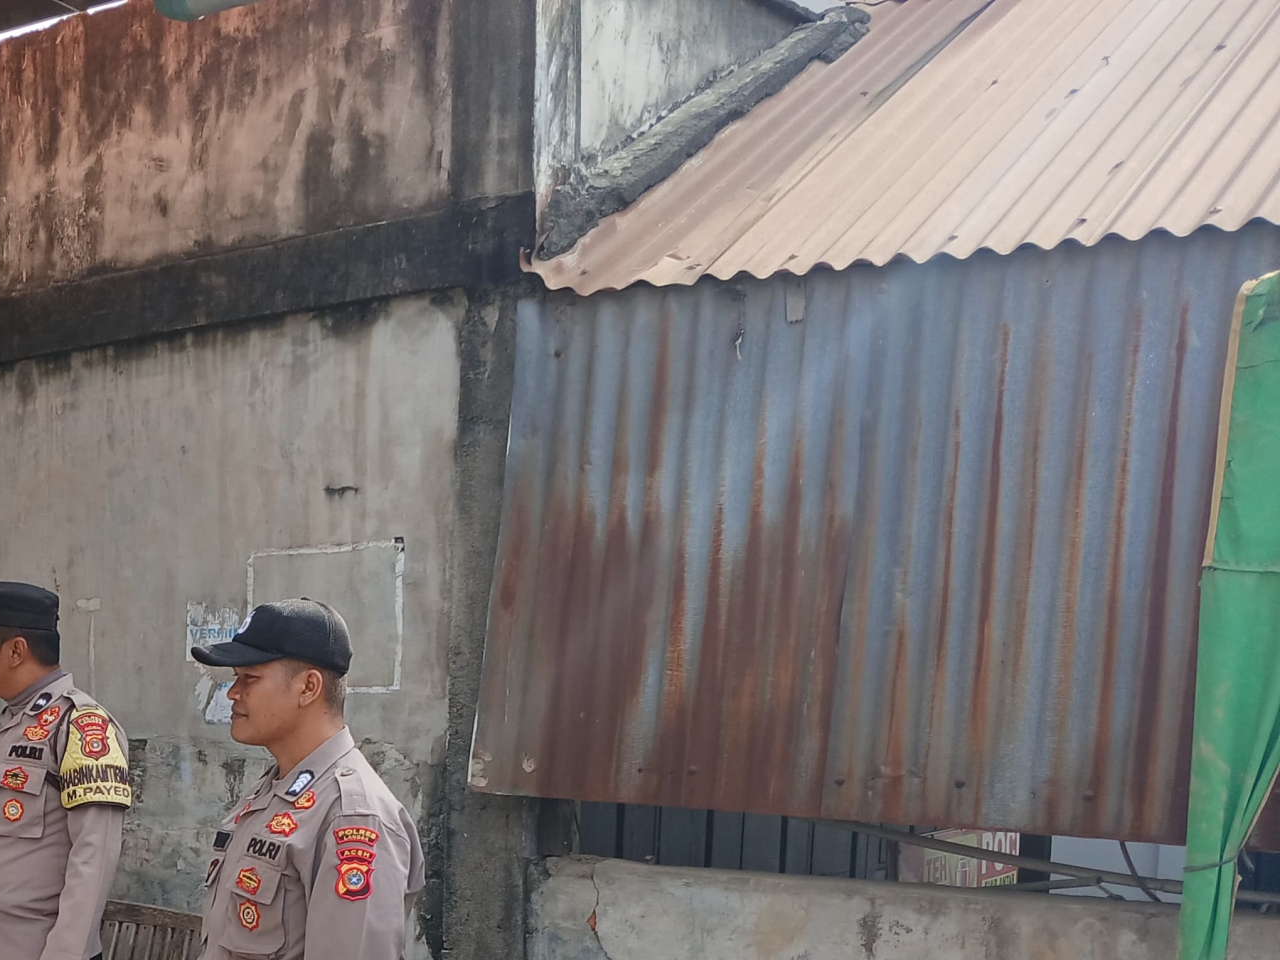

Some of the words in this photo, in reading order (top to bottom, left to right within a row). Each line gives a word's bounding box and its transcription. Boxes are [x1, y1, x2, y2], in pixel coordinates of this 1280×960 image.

[8, 744, 44, 760] POLRI
[338, 828, 376, 839] POLRES
[247, 837, 281, 860] POLRI
[343, 850, 370, 858] ACEH
